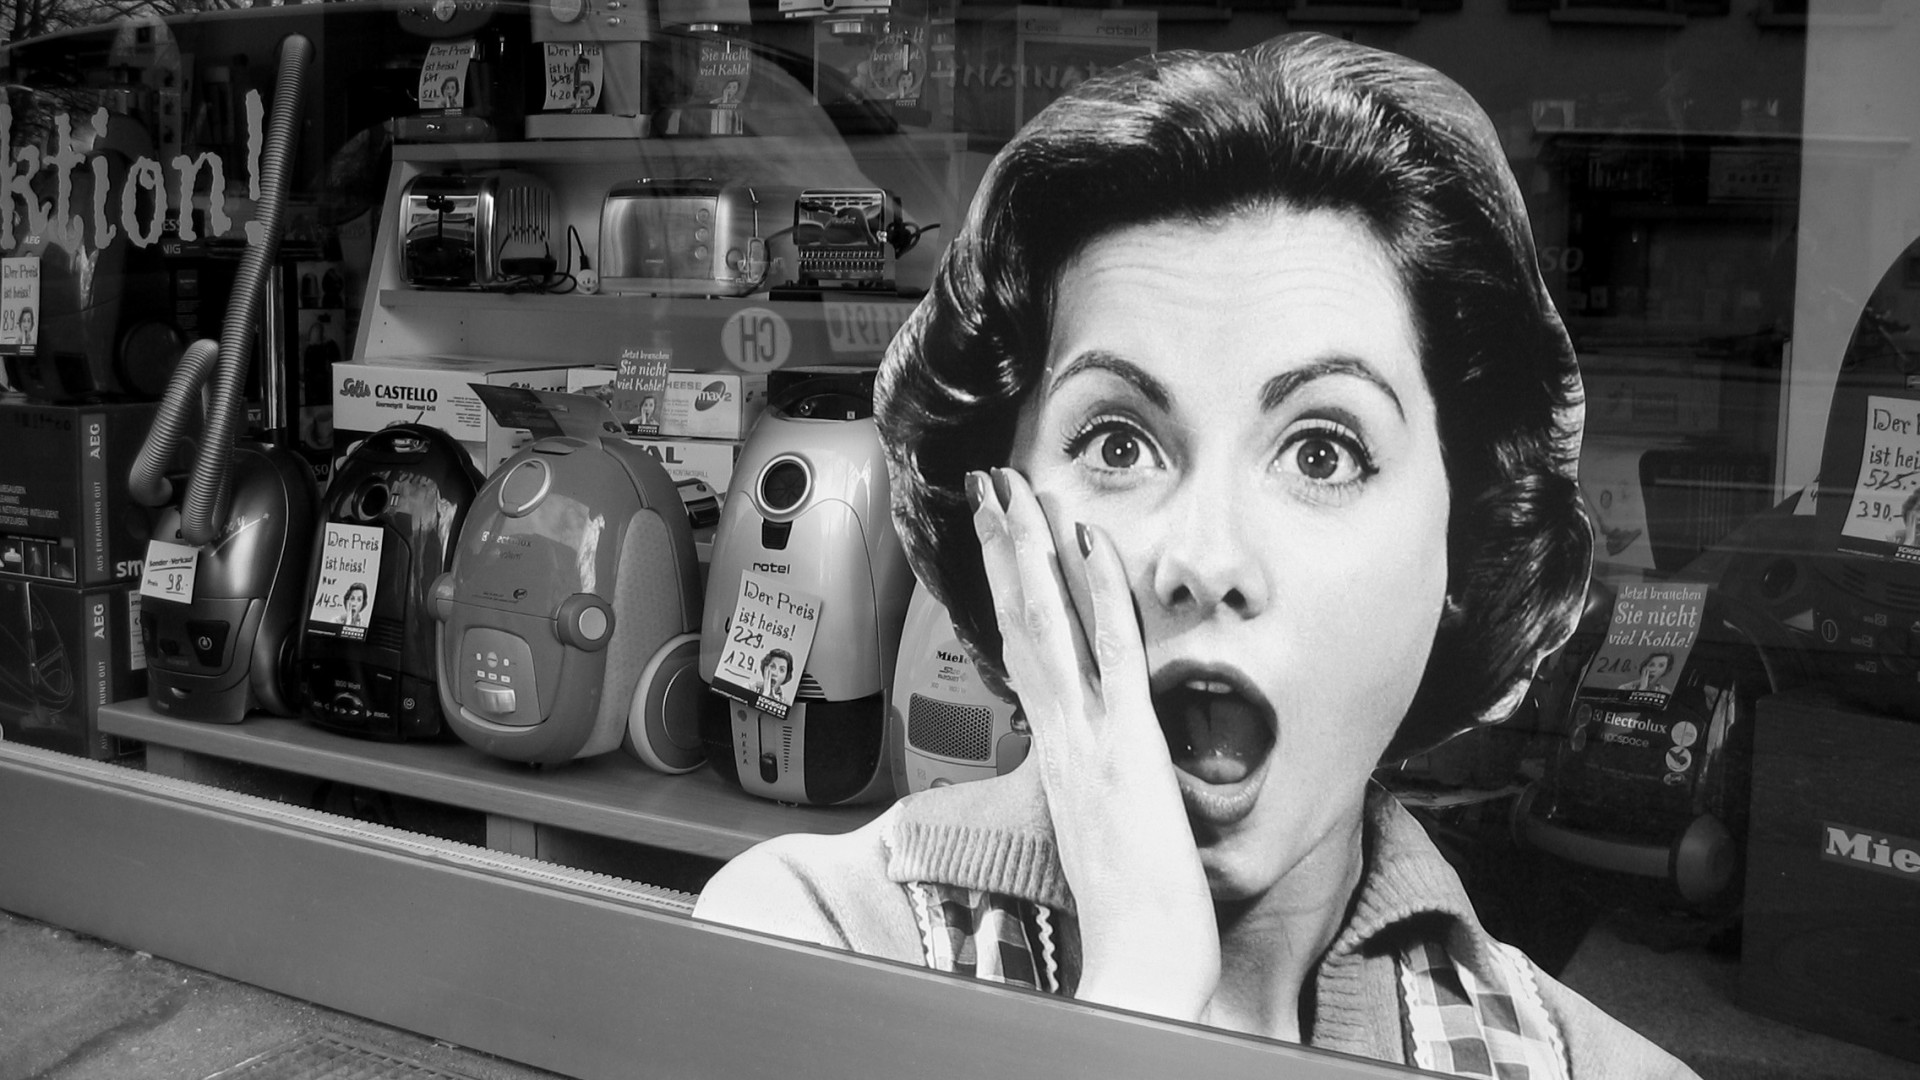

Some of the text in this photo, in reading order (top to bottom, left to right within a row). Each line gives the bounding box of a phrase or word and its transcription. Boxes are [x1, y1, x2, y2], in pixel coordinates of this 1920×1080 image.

[548, 44, 569, 57] Der
[701, 47, 719, 62] Sie
[549, 64, 561, 74] ist
[700, 61, 750, 76] viel Kohle!
[24, 236, 41, 245] AEG
[4, 264, 38, 279] Der Preis
[622, 349, 670, 360] Jetzt brauchen
[619, 359, 668, 377] Sie nicht
[375, 384, 438, 403] CASTELLO
[617, 377, 665, 392] viel Kohle!
[1873, 408, 1912, 435] Der
[90, 423, 101, 460] AEG
[1869, 445, 1891, 467] ist
[95, 501, 103, 552] ERFAHRUNG
[327, 531, 379, 552] Der Preis
[96, 555, 104, 572] AUS
[325, 555, 367, 574] ist heiss!
[752, 562, 791, 575] rotel
[743, 580, 815, 621] Der Preis
[1619, 586, 1703, 601] Jetzt brauchen
[93, 604, 105, 639] AEG
[739, 607, 797, 641] ist heiss!
[1615, 601, 1698, 629] Sie nicht
[1608, 629, 1694, 649] viel Kohle!
[98, 661, 106, 677] GUT
[1604, 711, 1668, 734] Electrolux
[1825, 827, 1920, 873] Mie
